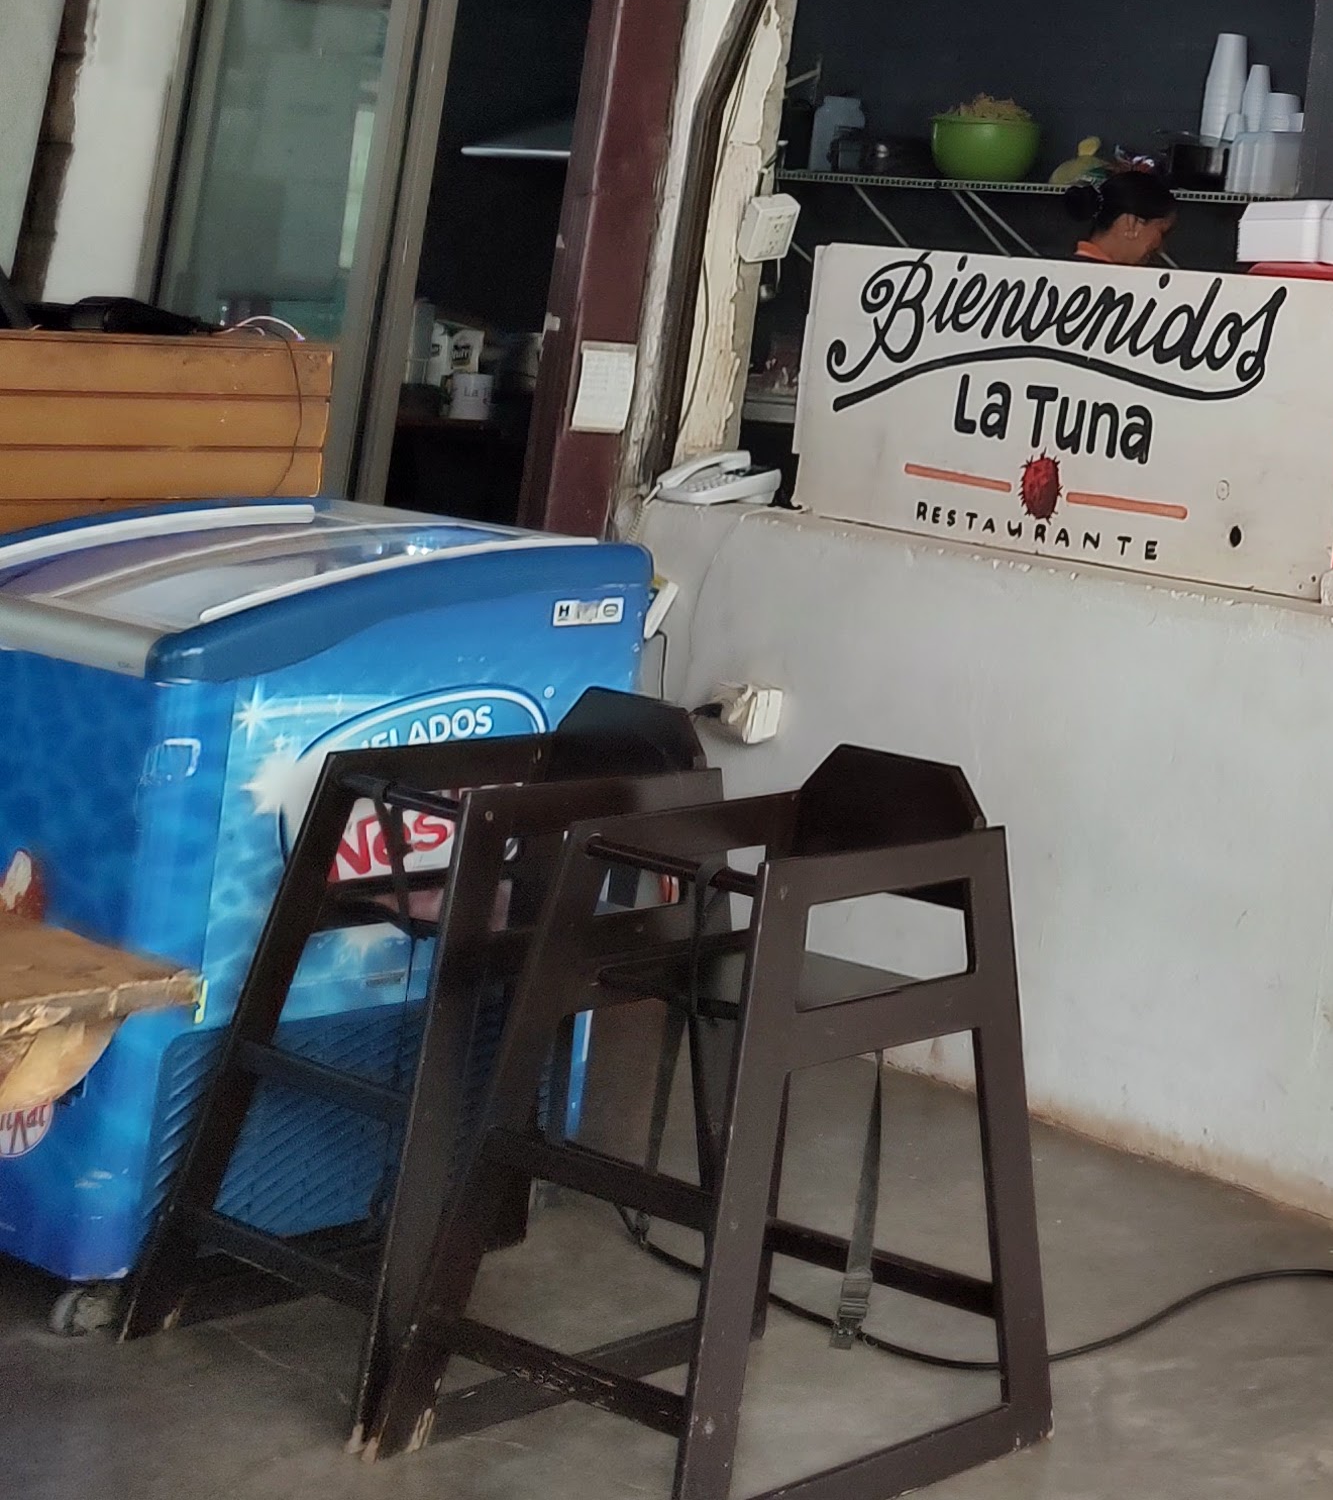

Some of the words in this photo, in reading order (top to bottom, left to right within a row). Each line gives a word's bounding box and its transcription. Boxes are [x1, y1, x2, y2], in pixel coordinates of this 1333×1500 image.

[827, 252, 1288, 384] Bienvenidos
[953, 373, 1013, 440] La
[1026, 384, 1155, 465] Tuna
[915, 500, 1159, 561] RESTAURANTE
[361, 704, 494, 749] ELADOS
